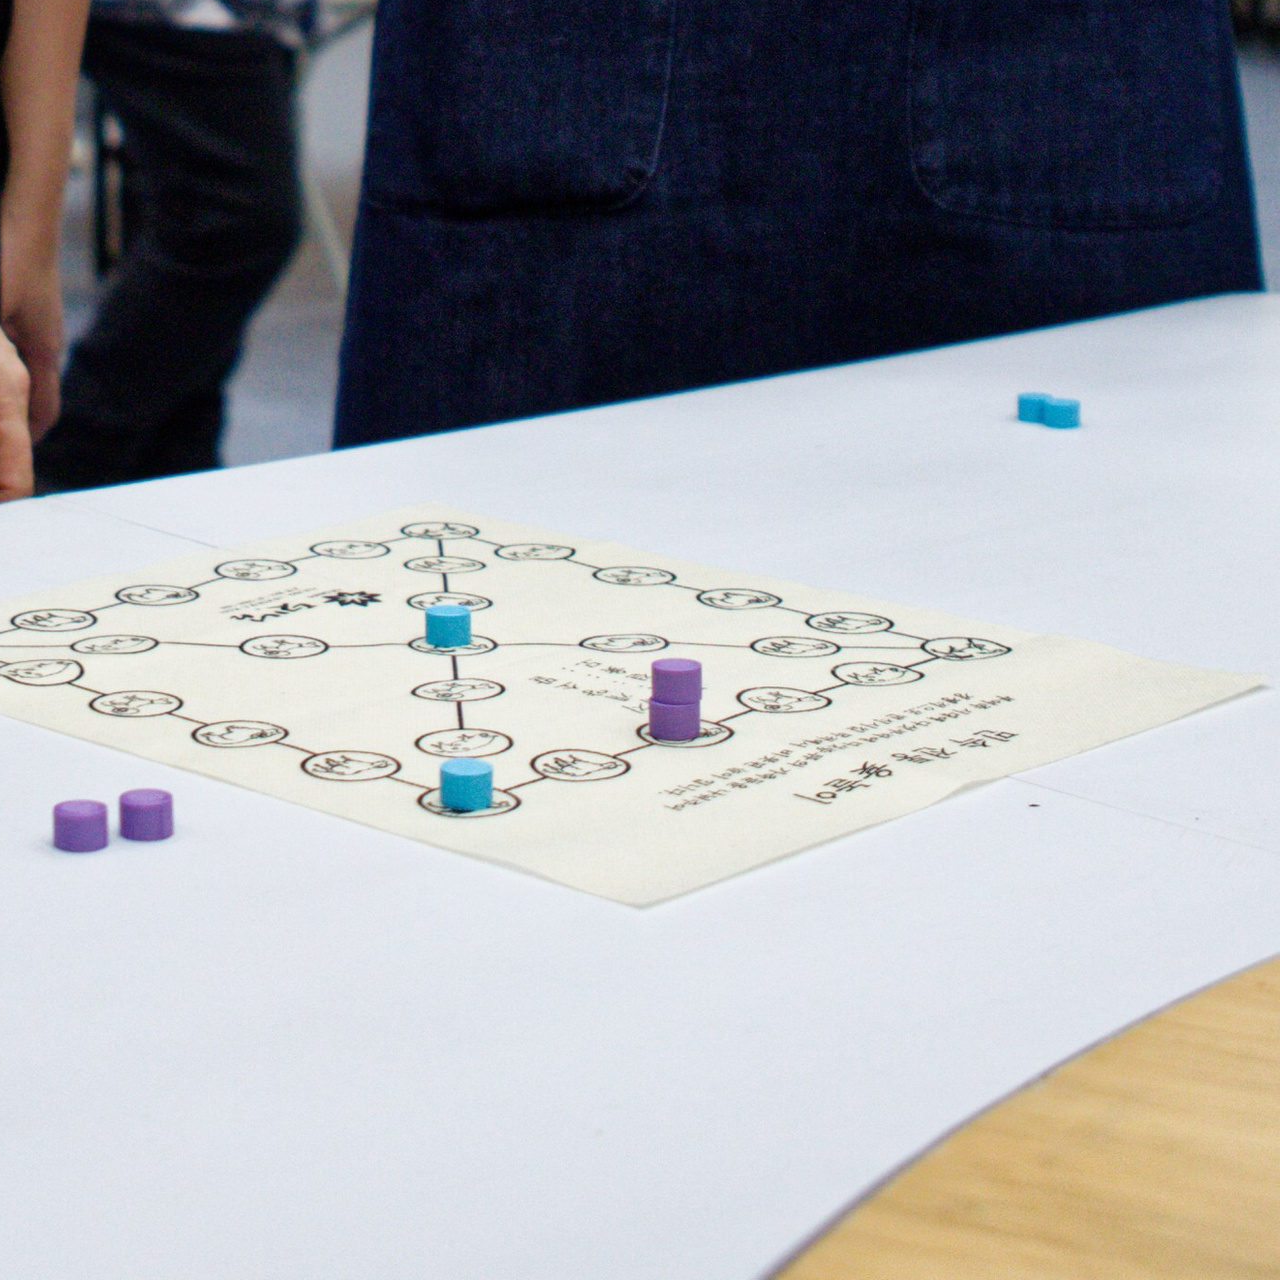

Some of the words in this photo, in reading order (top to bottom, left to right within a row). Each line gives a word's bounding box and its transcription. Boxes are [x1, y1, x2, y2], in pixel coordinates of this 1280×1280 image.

[949, 730, 1019, 748] 민속
[891, 747, 957, 764] 전통
[793, 761, 893, 805] 윷놀이
